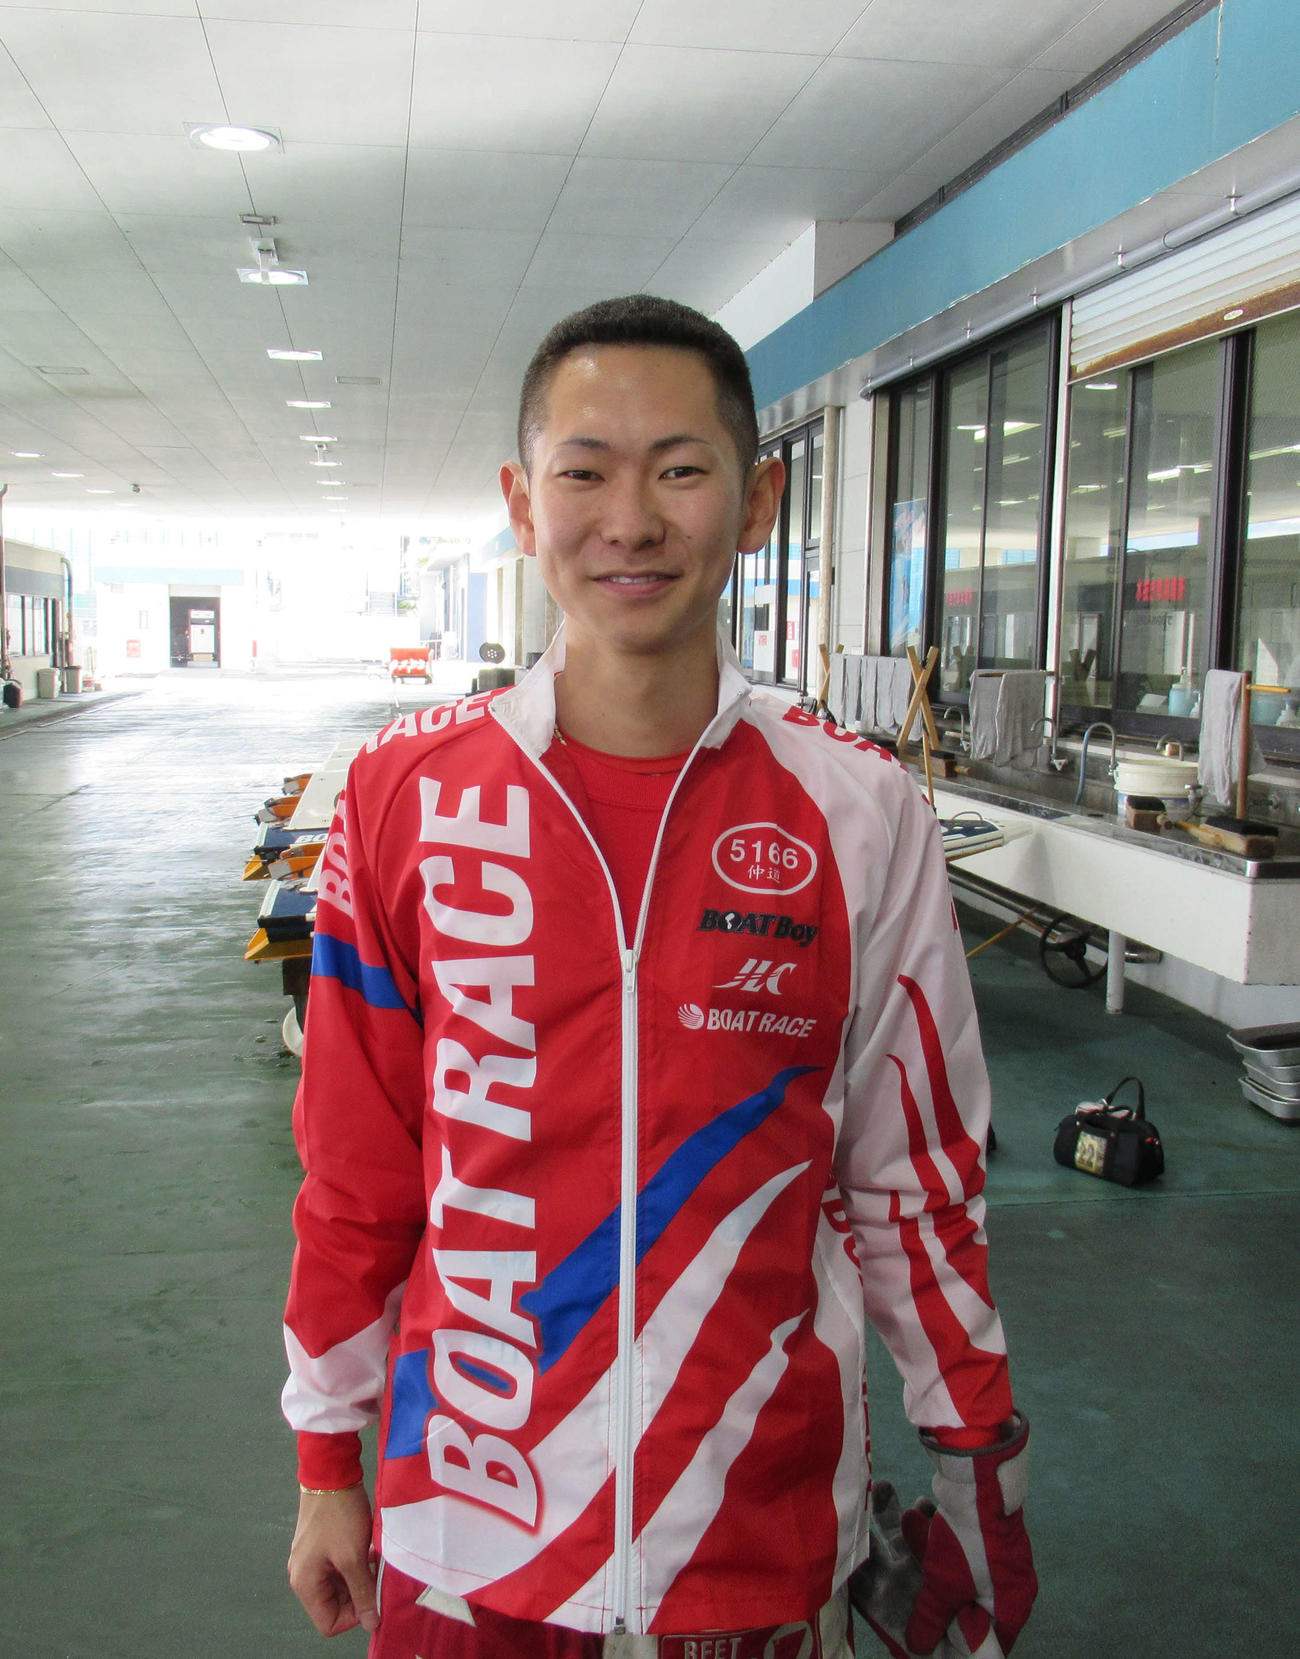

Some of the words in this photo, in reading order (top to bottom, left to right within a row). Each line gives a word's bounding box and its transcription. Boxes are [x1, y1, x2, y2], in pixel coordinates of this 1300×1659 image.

[782, 705, 911, 774] BOA
[729, 838, 799, 870] 5166
[418, 775, 537, 1142] RACE
[706, 1007, 760, 1032] BOAT
[757, 1012, 817, 1037] RACE
[426, 1142, 540, 1529] BOAT
